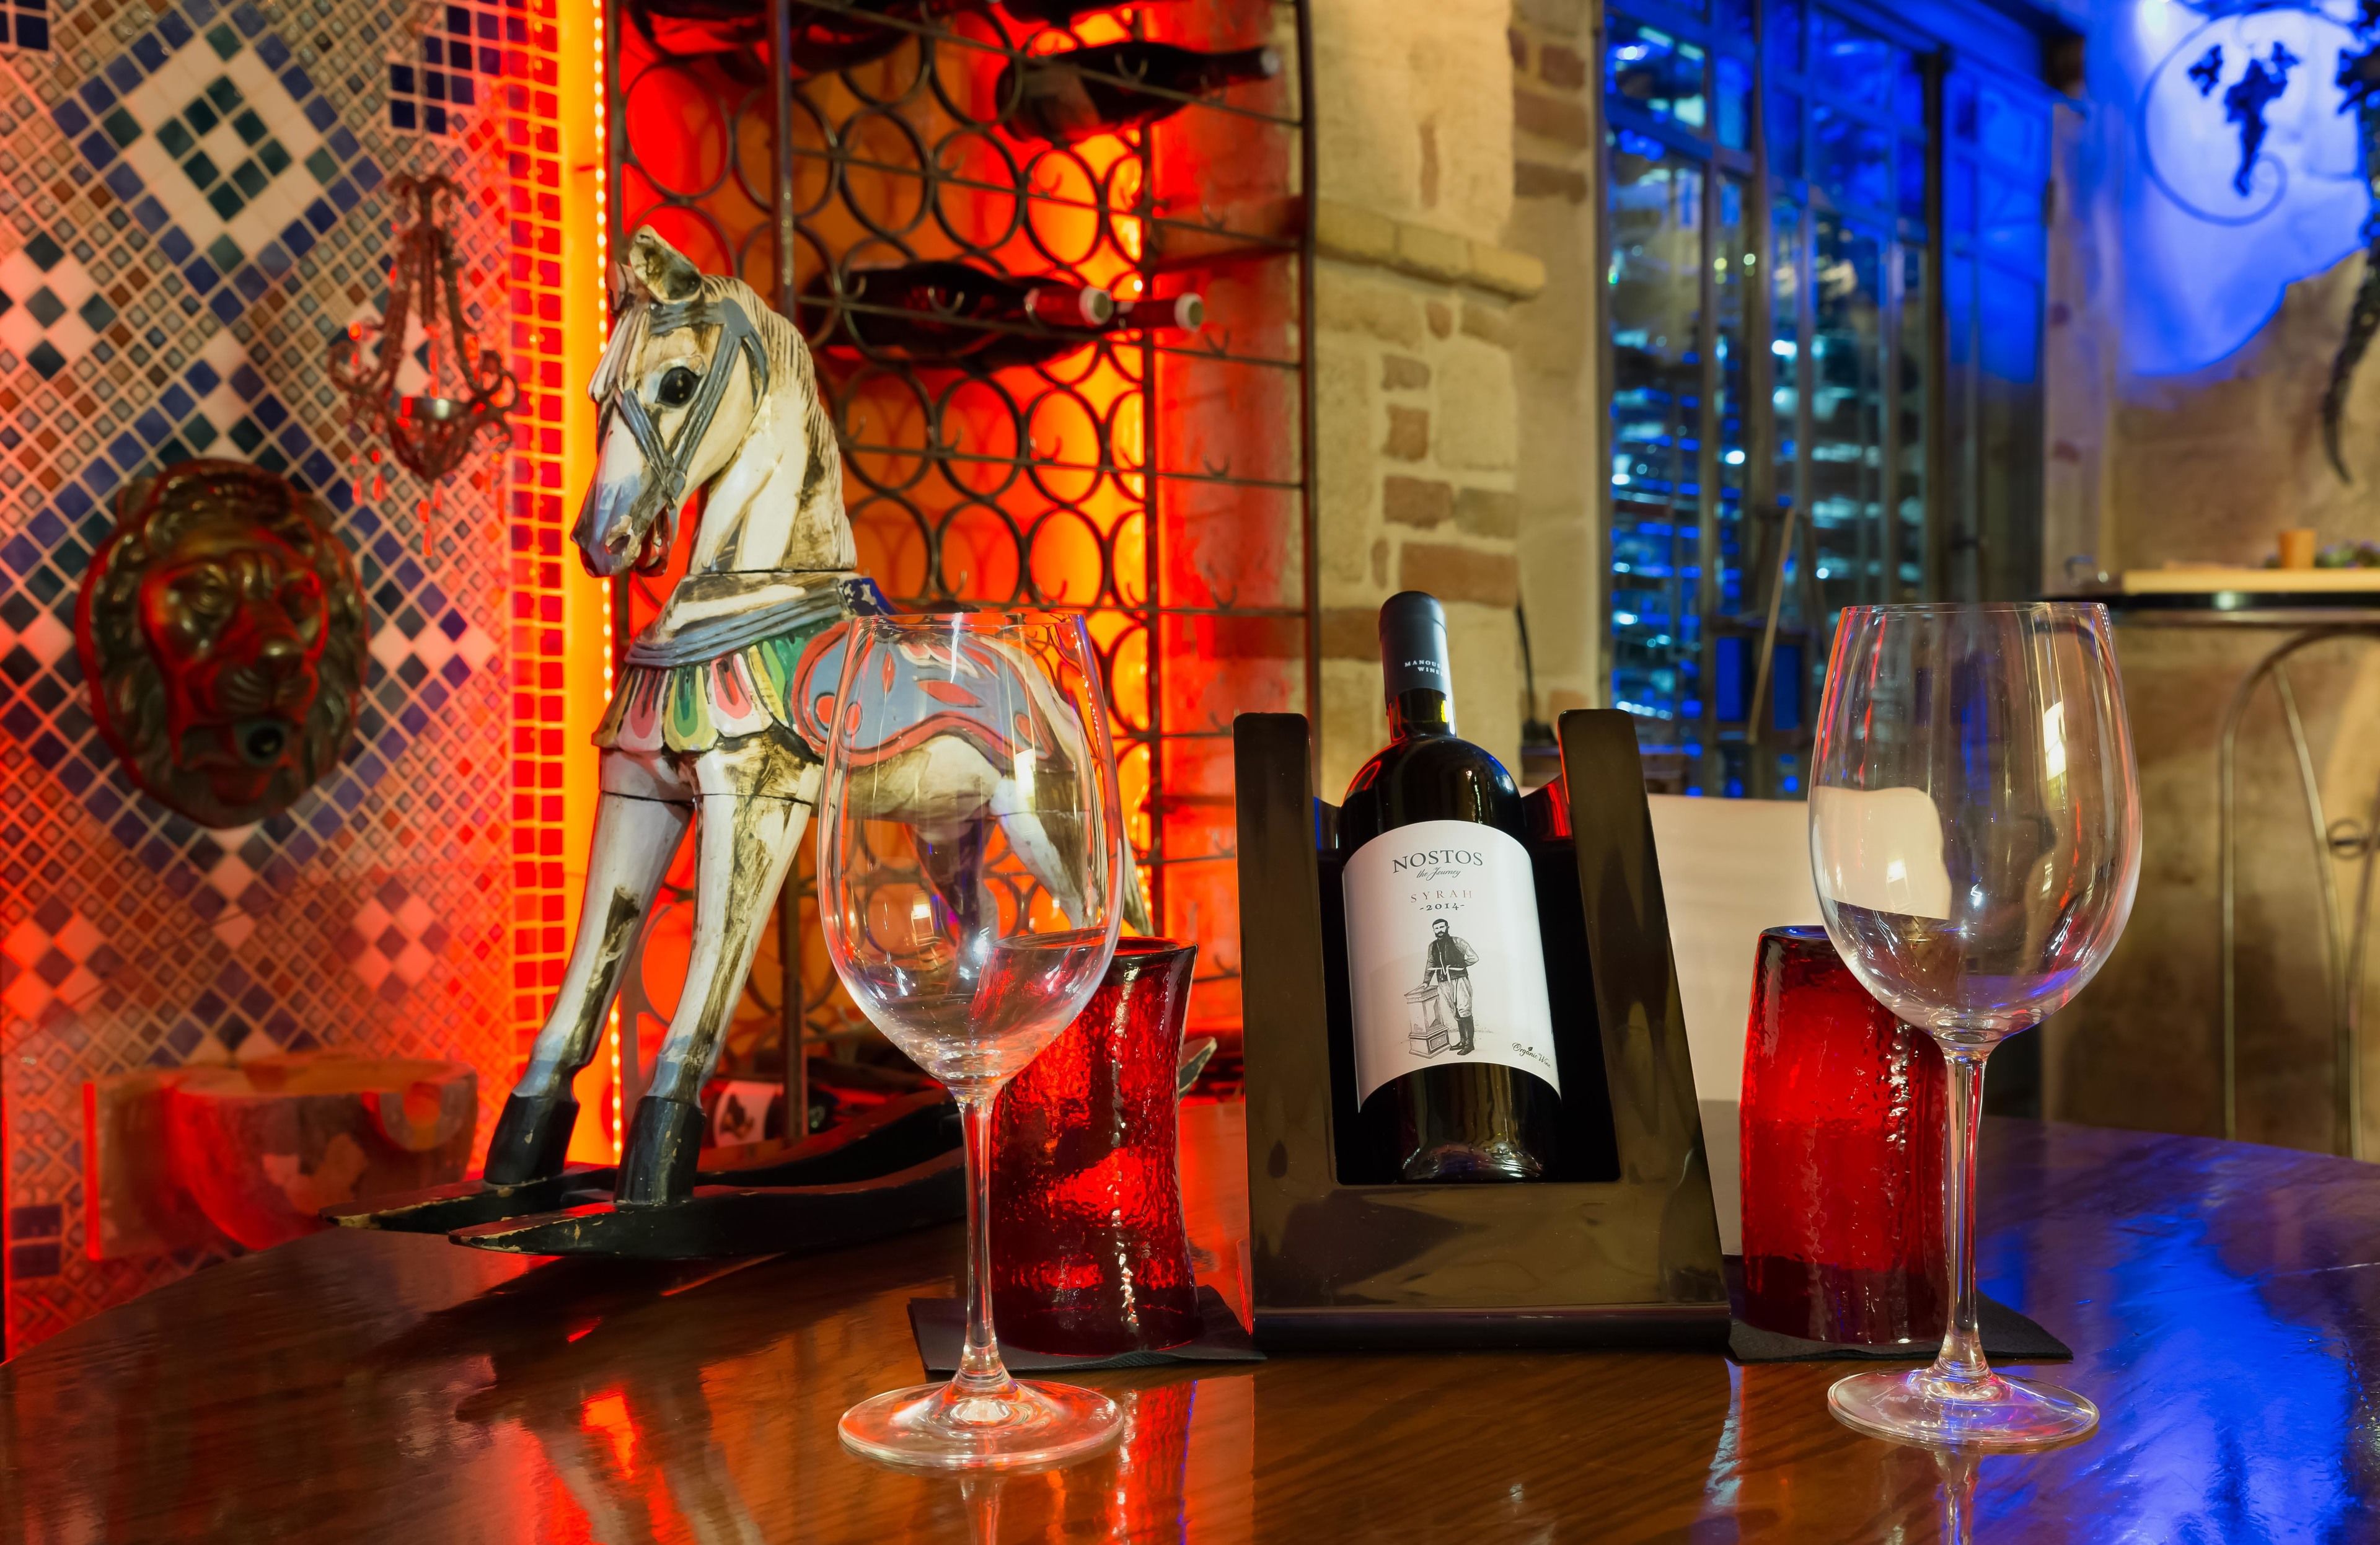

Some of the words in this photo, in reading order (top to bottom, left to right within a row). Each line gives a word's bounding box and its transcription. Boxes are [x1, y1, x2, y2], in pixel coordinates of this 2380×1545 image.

[1392, 850, 1483, 874] NOSTOS
[1416, 869, 1428, 878] the
[1426, 867, 1461, 881] Journey
[1411, 890, 1472, 903] SYRAH
[1512, 1042, 1538, 1059] Organic
